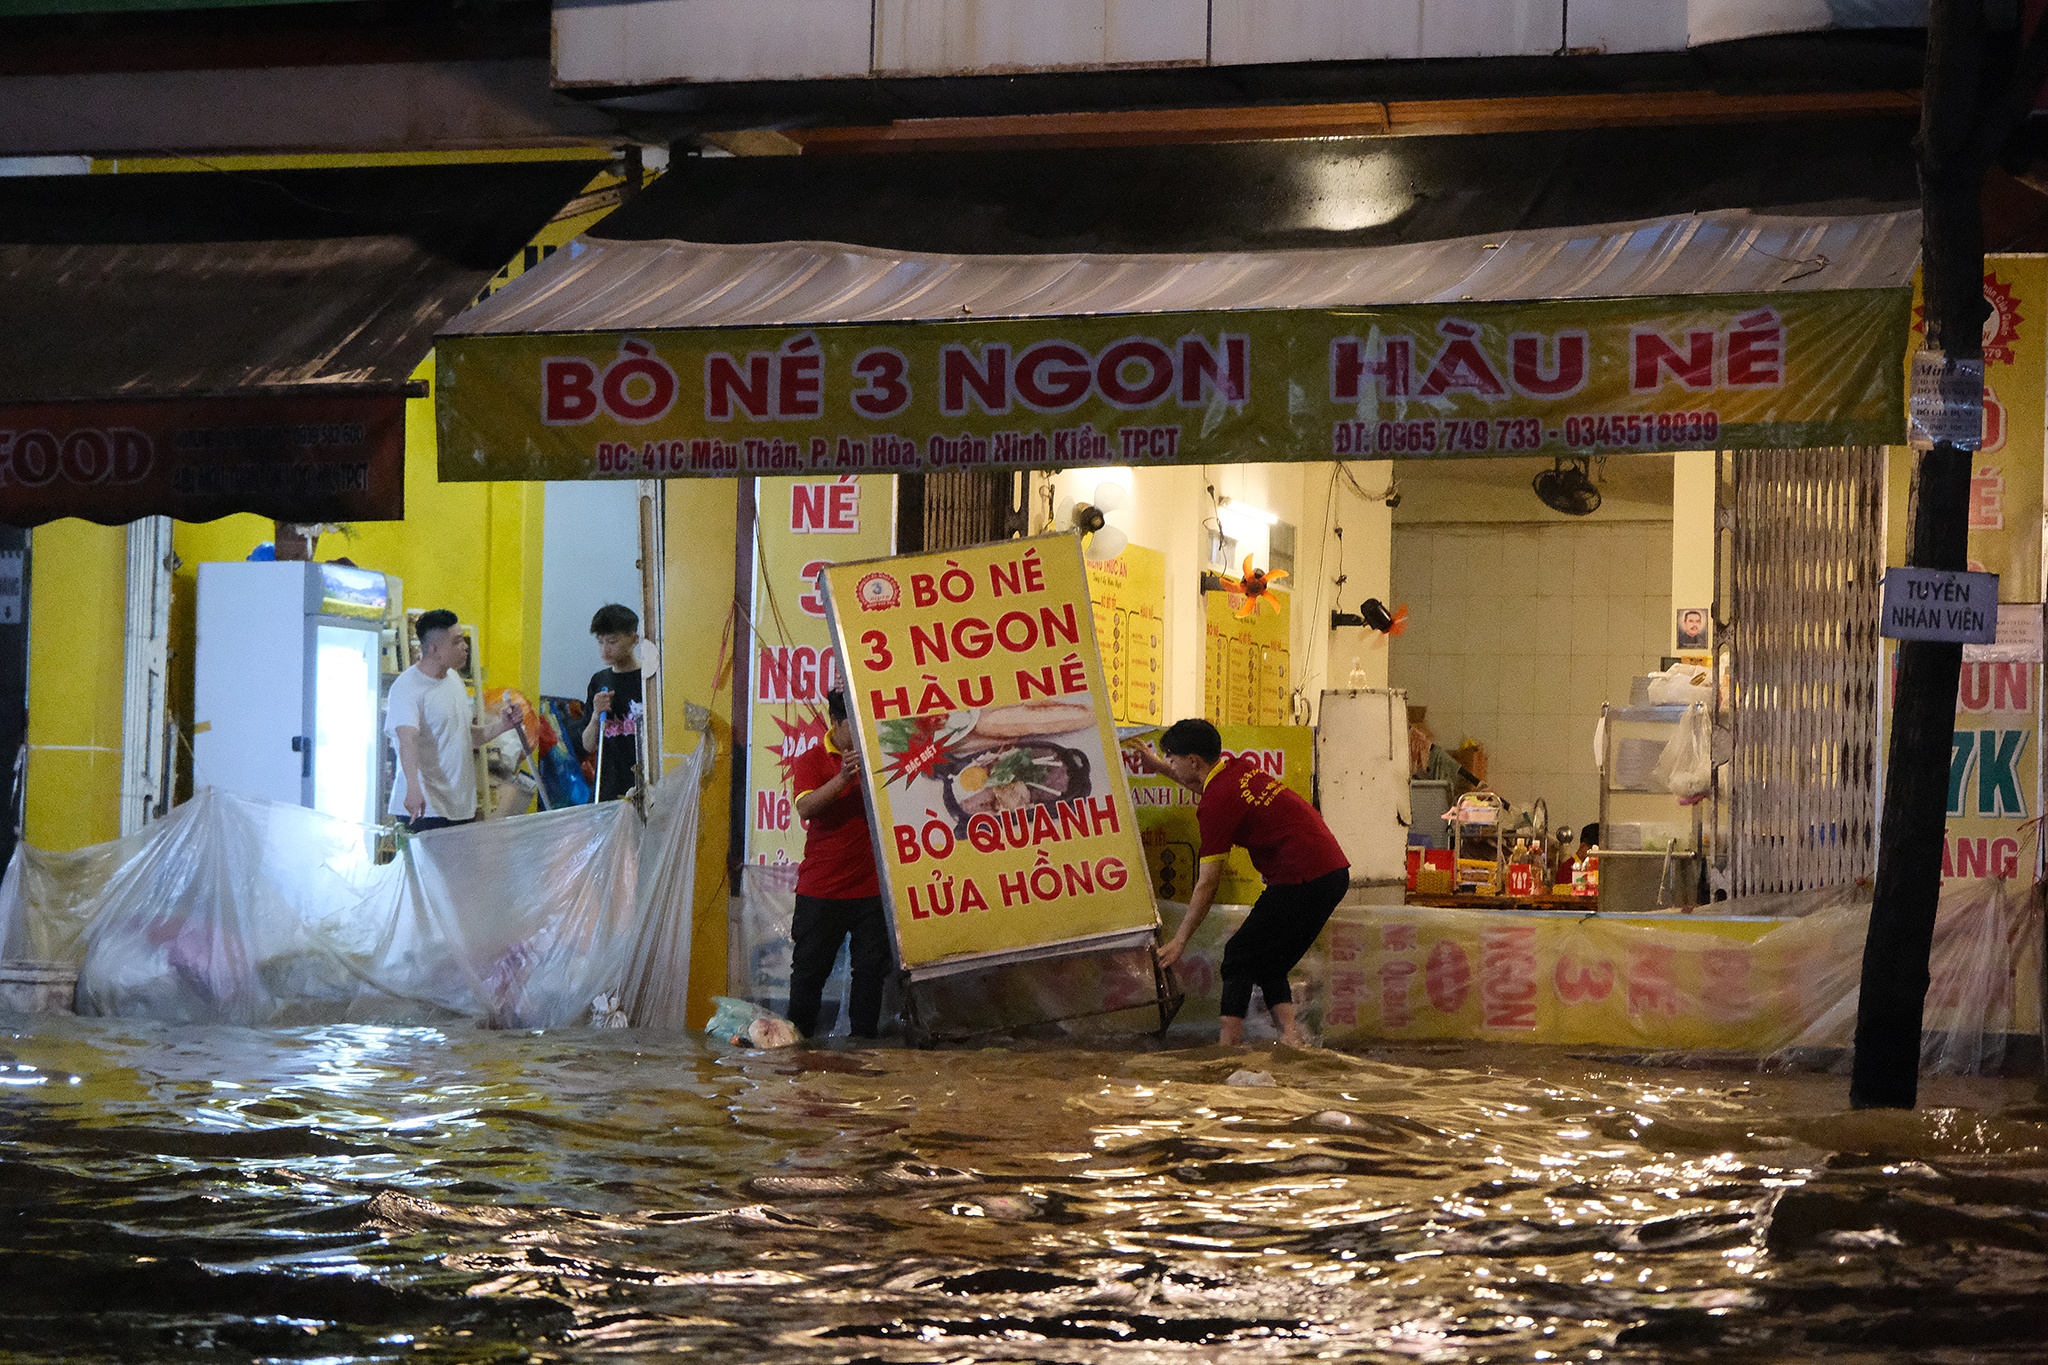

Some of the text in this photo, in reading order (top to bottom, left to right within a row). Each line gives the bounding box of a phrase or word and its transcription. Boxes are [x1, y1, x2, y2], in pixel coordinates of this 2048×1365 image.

[543, 308, 1783, 424] BÒ NÉ 3 NGON HÀU NÉ
[642, 441, 685, 470] 41C
[811, 436, 828, 467] P.
[836, 436, 865, 466] An
[929, 433, 987, 470] Quận
[993, 432, 1048, 463] Ninh
[1120, 427, 1179, 459] TPCT
[1377, 420, 1436, 452] 0965
[1444, 420, 1489, 451] 749
[1495, 418, 1542, 449] 733
[791, 475, 857, 530] NÉ
[910, 546, 1046, 609] BÒ NÉ
[860, 629, 895, 672] 3
[909, 603, 1080, 667] NGON
[869, 673, 995, 721] HÀU
[1014, 652, 1089, 701] NÉ
[757, 789, 791, 831] Né
[893, 794, 1121, 865] BÒ QUANH
[906, 849, 1129, 921] LỬA HỒNG
[1555, 953, 1615, 1003] 3
